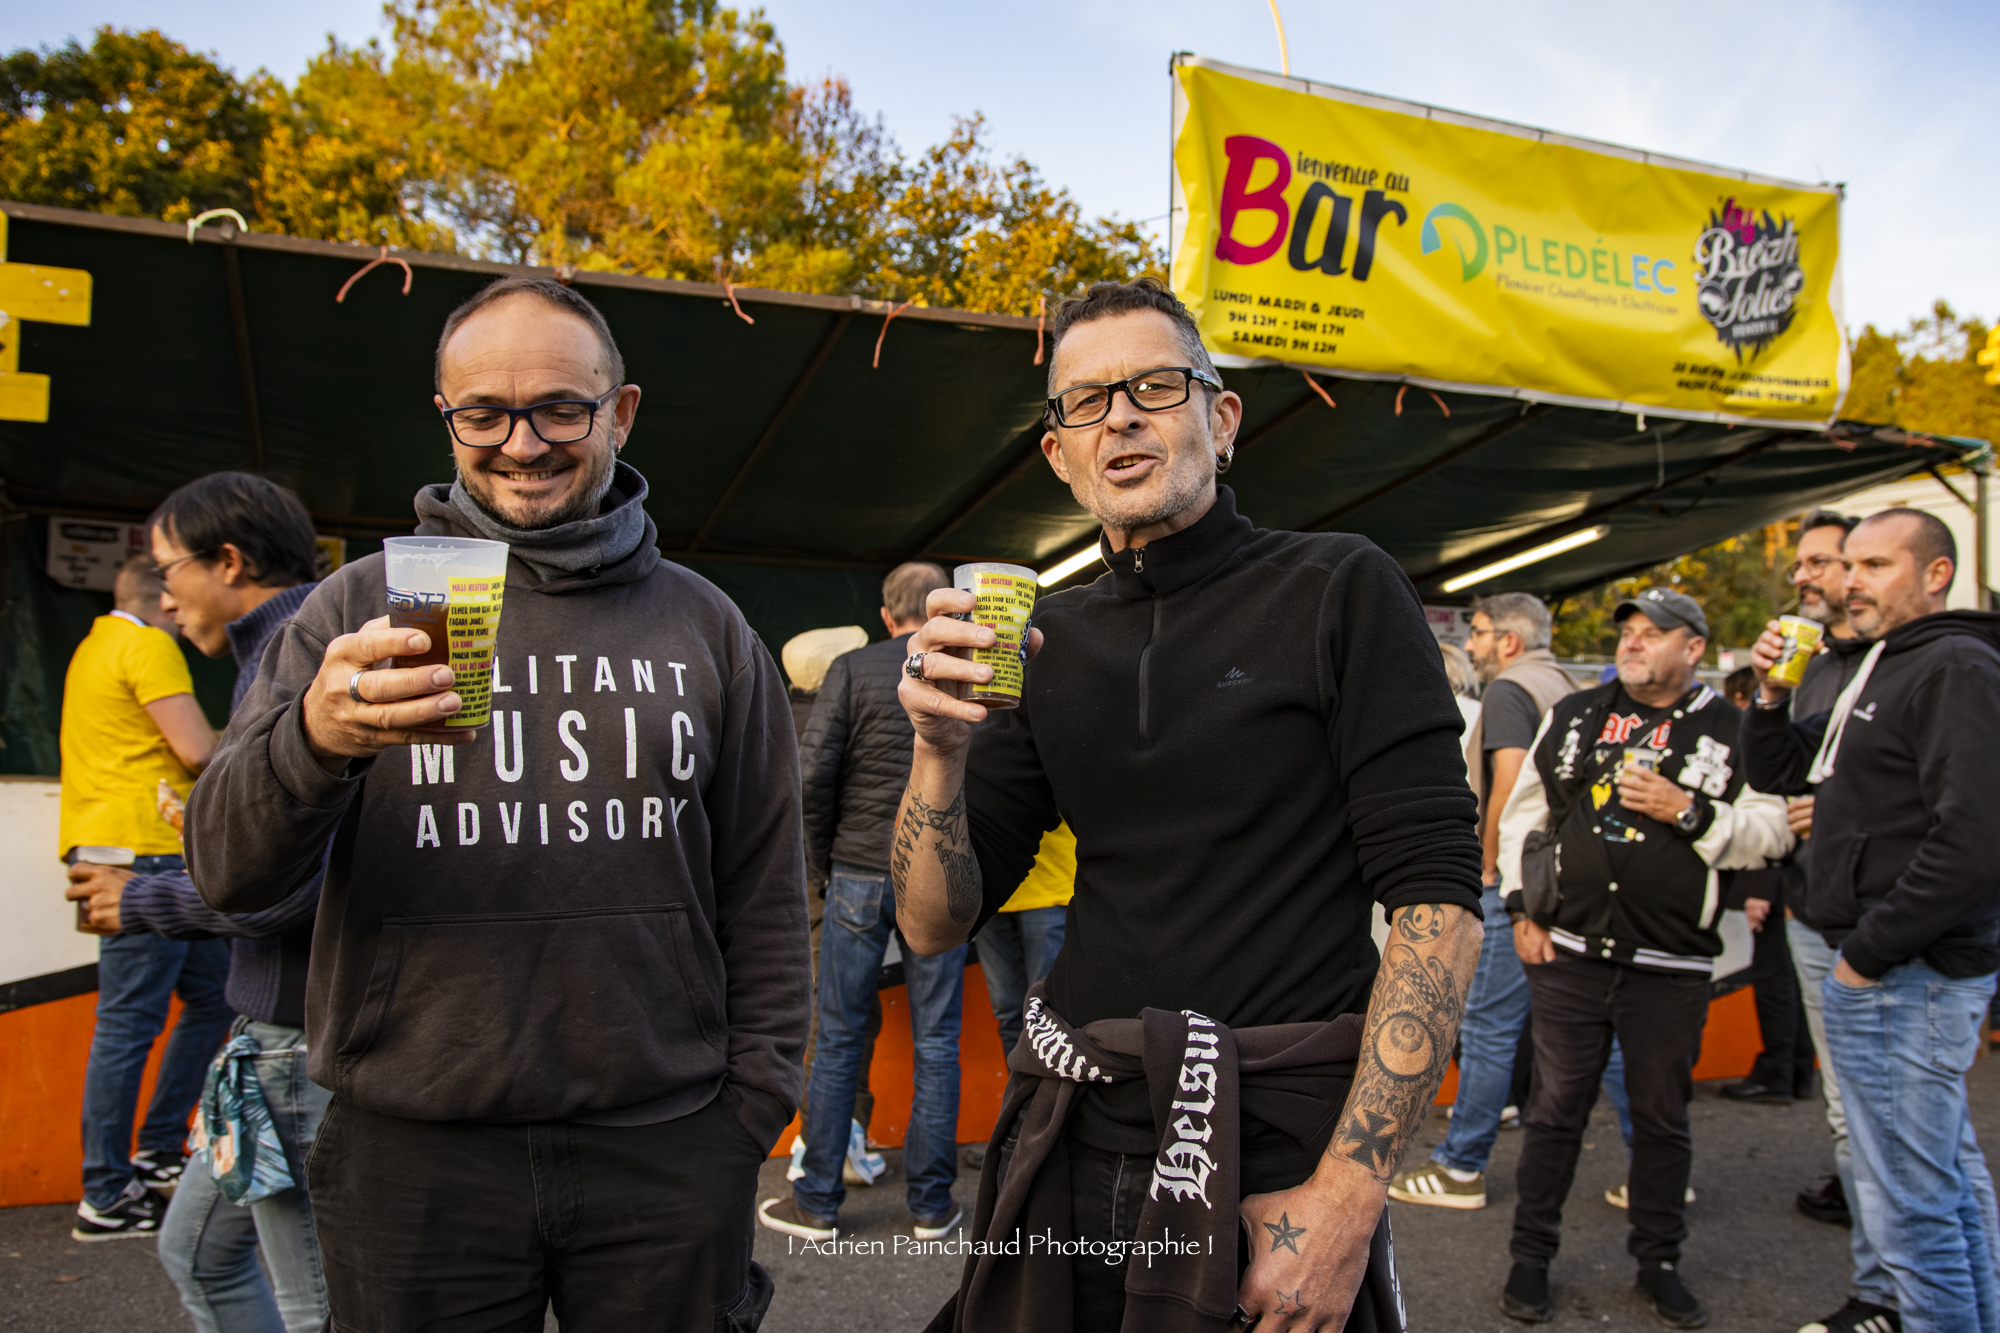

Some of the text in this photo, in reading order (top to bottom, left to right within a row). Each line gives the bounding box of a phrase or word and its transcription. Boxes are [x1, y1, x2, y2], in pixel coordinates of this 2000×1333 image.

[1385, 171, 1410, 193] au
[1214, 133, 1409, 282] Bar
[1723, 196, 1756, 243] by
[1493, 223, 1678, 295] PLEDÉLEC
[1213, 288, 1366, 320] LUNDI MARDI & JEUDI
[1228, 310, 1248, 323] 9H
[1252, 314, 1278, 327] 12H
[1292, 319, 1318, 334] 14H
[1321, 323, 1346, 336] 17H
[1232, 330, 1338, 354] SAMEDI 9H 12H
[452, 584, 467, 592] MASS
[469, 606, 481, 614] FOOD
[993, 605, 1008, 613] JONES
[449, 618, 468, 626] TAGADA
[469, 617, 484, 625] JONES
[467, 629, 475, 637] DU
[452, 641, 459, 649] LA
[492, 655, 687, 696] LITANT
[416, 796, 689, 849] ADVISORY
